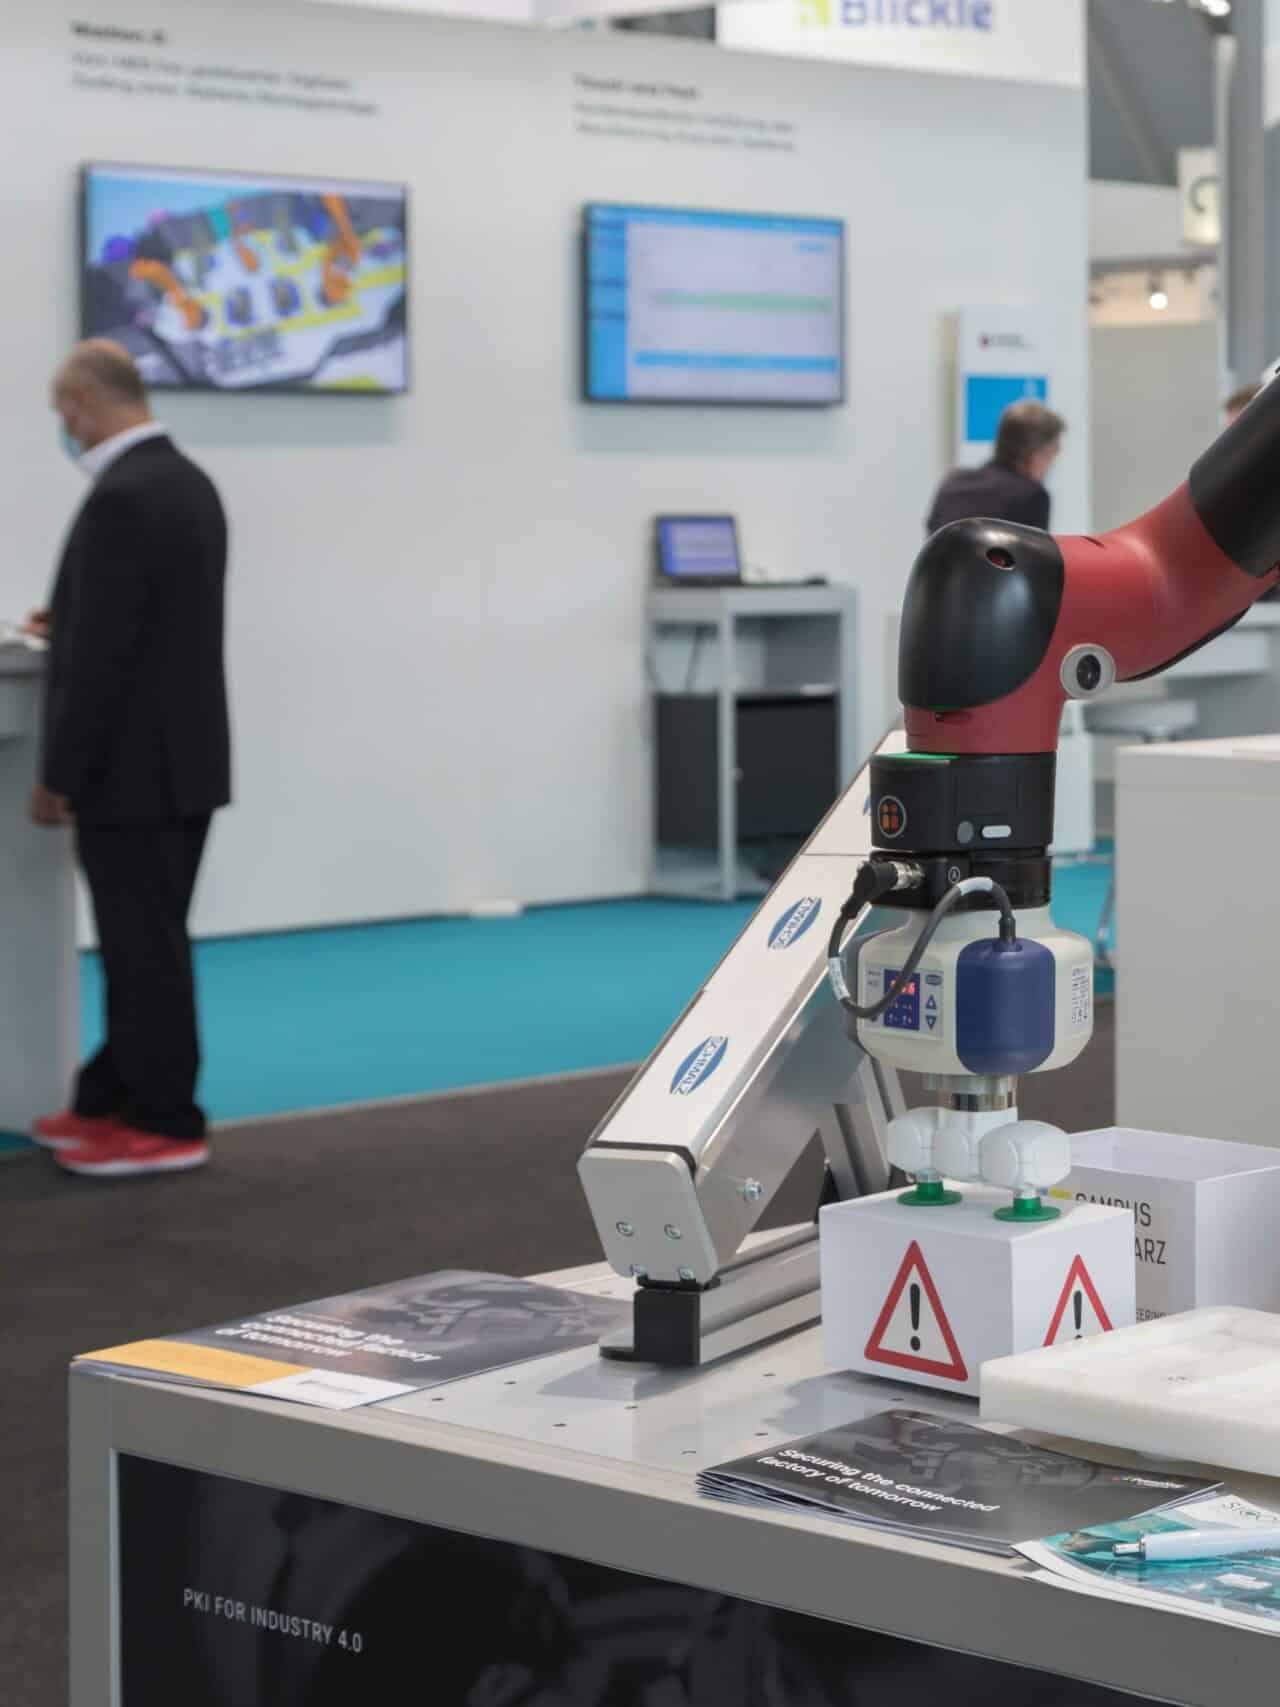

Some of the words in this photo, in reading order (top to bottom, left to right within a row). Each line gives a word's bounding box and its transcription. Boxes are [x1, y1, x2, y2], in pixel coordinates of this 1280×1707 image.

[1135, 1237, 1166, 1265] ARZ
[757, 1456, 827, 1478] factory
[825, 1474, 853, 1484] of
[848, 1480, 943, 1512] tomorrow
[778, 1449, 863, 1477] Securing
[861, 1472, 894, 1486] the
[895, 1483, 1001, 1513] connected
[183, 1587, 210, 1612] PKI
[215, 1596, 246, 1622] FOR
[250, 1605, 334, 1644] INDUSTRY
[337, 1629, 363, 1653] 4.0
